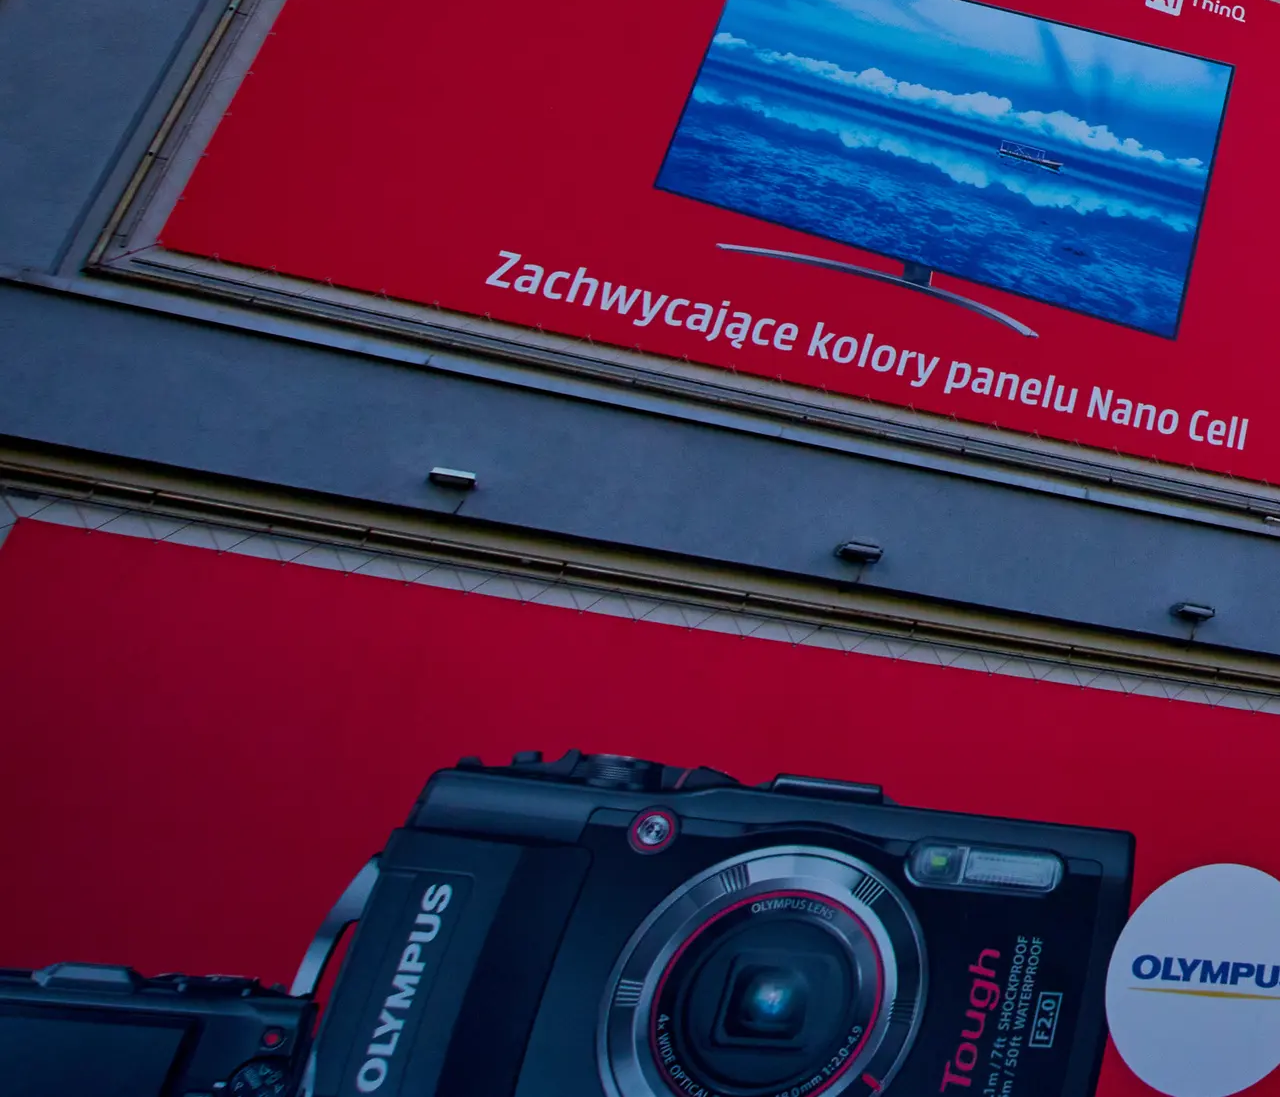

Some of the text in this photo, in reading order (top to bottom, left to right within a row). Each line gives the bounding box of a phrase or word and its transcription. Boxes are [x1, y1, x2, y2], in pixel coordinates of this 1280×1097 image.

[485, 248, 1250, 453] Zachwycające kolory panelu Nano Cell
[751, 898, 836, 921] OLYMPUS LENS
[356, 883, 453, 1093] OLYMPUS
[940, 947, 1001, 1093] Tough
[998, 935, 1028, 1031] SHOCKPROOF
[1004, 1035, 1022, 1068] 50ft
[1013, 936, 1044, 1030] WATERPROOF
[1034, 998, 1057, 1041] F2.0
[657, 1033, 677, 1063] WIDE
